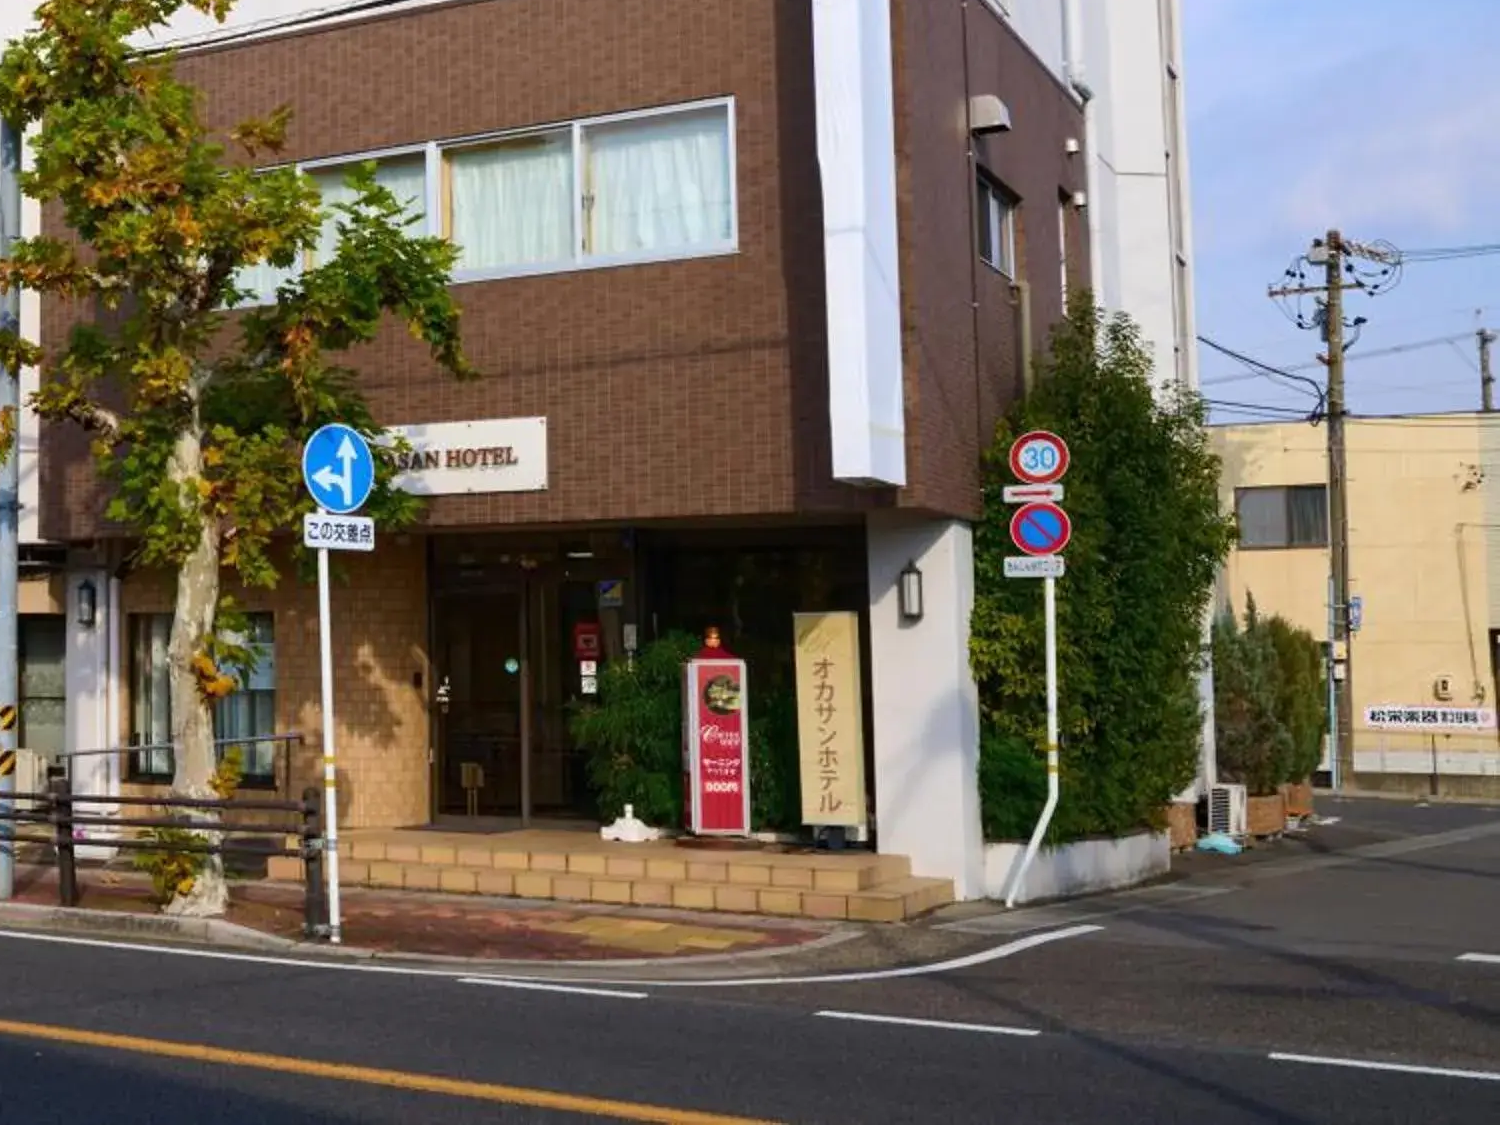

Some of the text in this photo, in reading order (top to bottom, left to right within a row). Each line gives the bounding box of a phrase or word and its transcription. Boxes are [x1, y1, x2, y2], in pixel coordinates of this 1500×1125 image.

[445, 446, 519, 467] HOTEL
[1022, 445, 1056, 471] 30
[307, 521, 372, 543] この交差点
[812, 658, 842, 813] オカサンホテル
